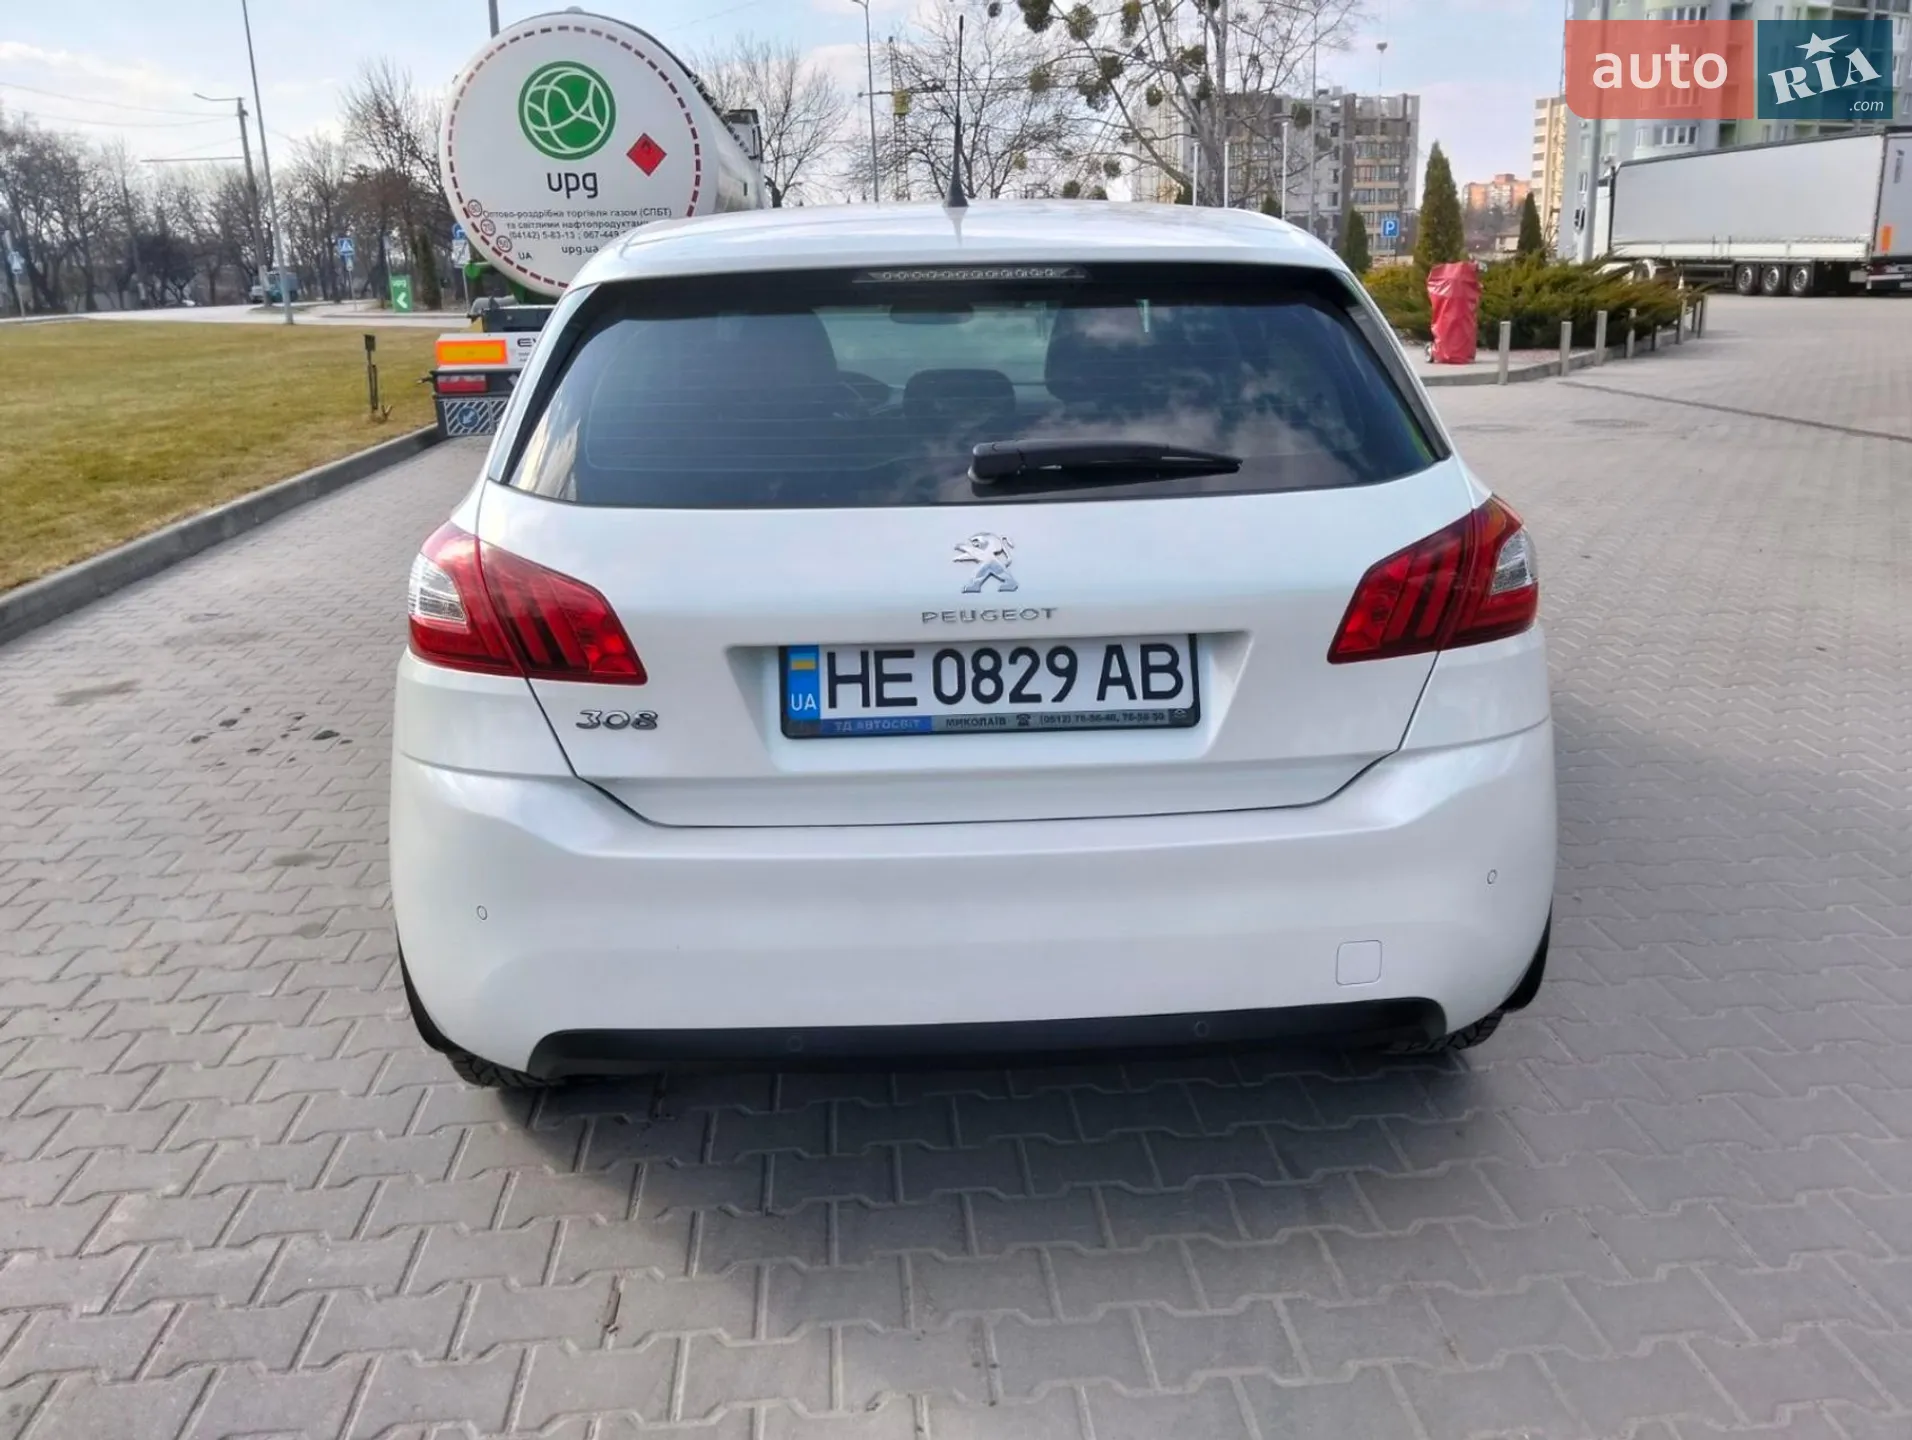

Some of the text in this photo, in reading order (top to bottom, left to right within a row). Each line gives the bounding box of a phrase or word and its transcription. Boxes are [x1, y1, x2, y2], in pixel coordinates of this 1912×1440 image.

[546, 172, 599, 199] upg
[566, 209, 608, 218] торгівля
[610, 209, 638, 217] газом
[639, 207, 672, 218] (СПБТ)
[1385, 220, 1396, 235] P
[518, 251, 533, 260] UA
[922, 607, 1058, 624] PEUGEOT
[826, 643, 1185, 709] HE 0829 AB
[790, 692, 818, 711] UA
[575, 708, 659, 731] 308
